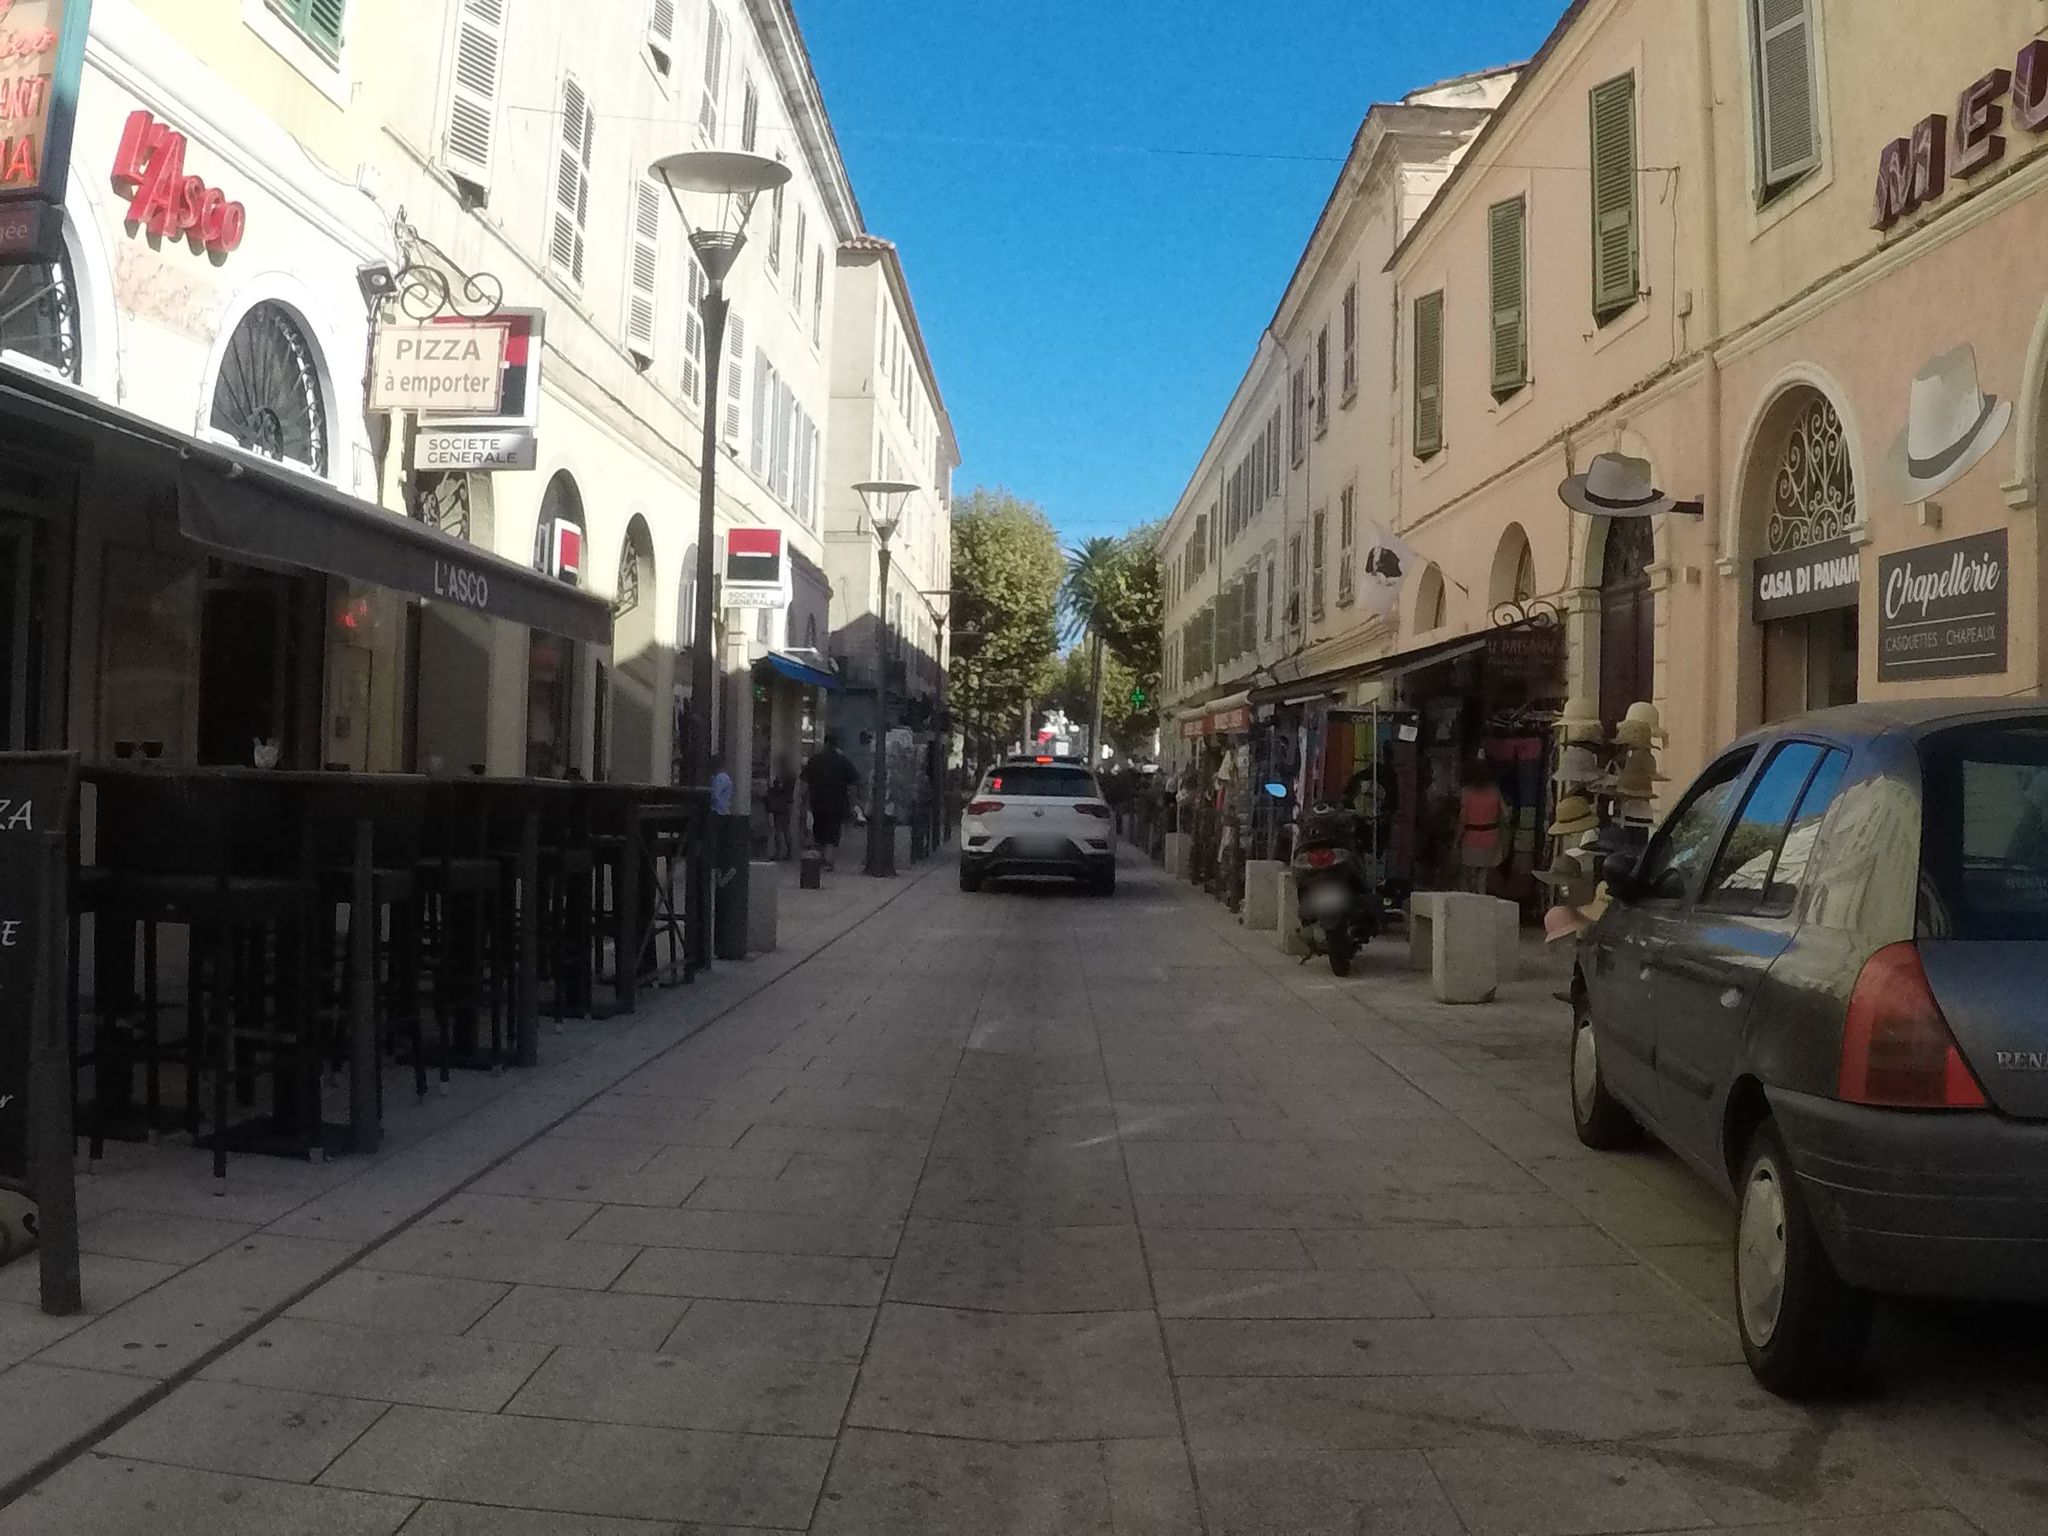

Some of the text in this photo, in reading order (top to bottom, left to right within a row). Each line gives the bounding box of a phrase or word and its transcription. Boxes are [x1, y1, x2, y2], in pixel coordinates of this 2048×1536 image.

[395, 338, 481, 361] PIZZA
[384, 369, 490, 398] à emporter
[427, 451, 518, 464] GENERALE
[428, 438, 501, 451] SOCIETE
[433, 560, 488, 608] L'ASCO
[1759, 571, 1793, 602] CASA
[1796, 566, 1811, 595] DI
[1885, 551, 2001, 620] Chapellerie
[1885, 625, 1996, 653] CASQUETTES CHAPEAUX
